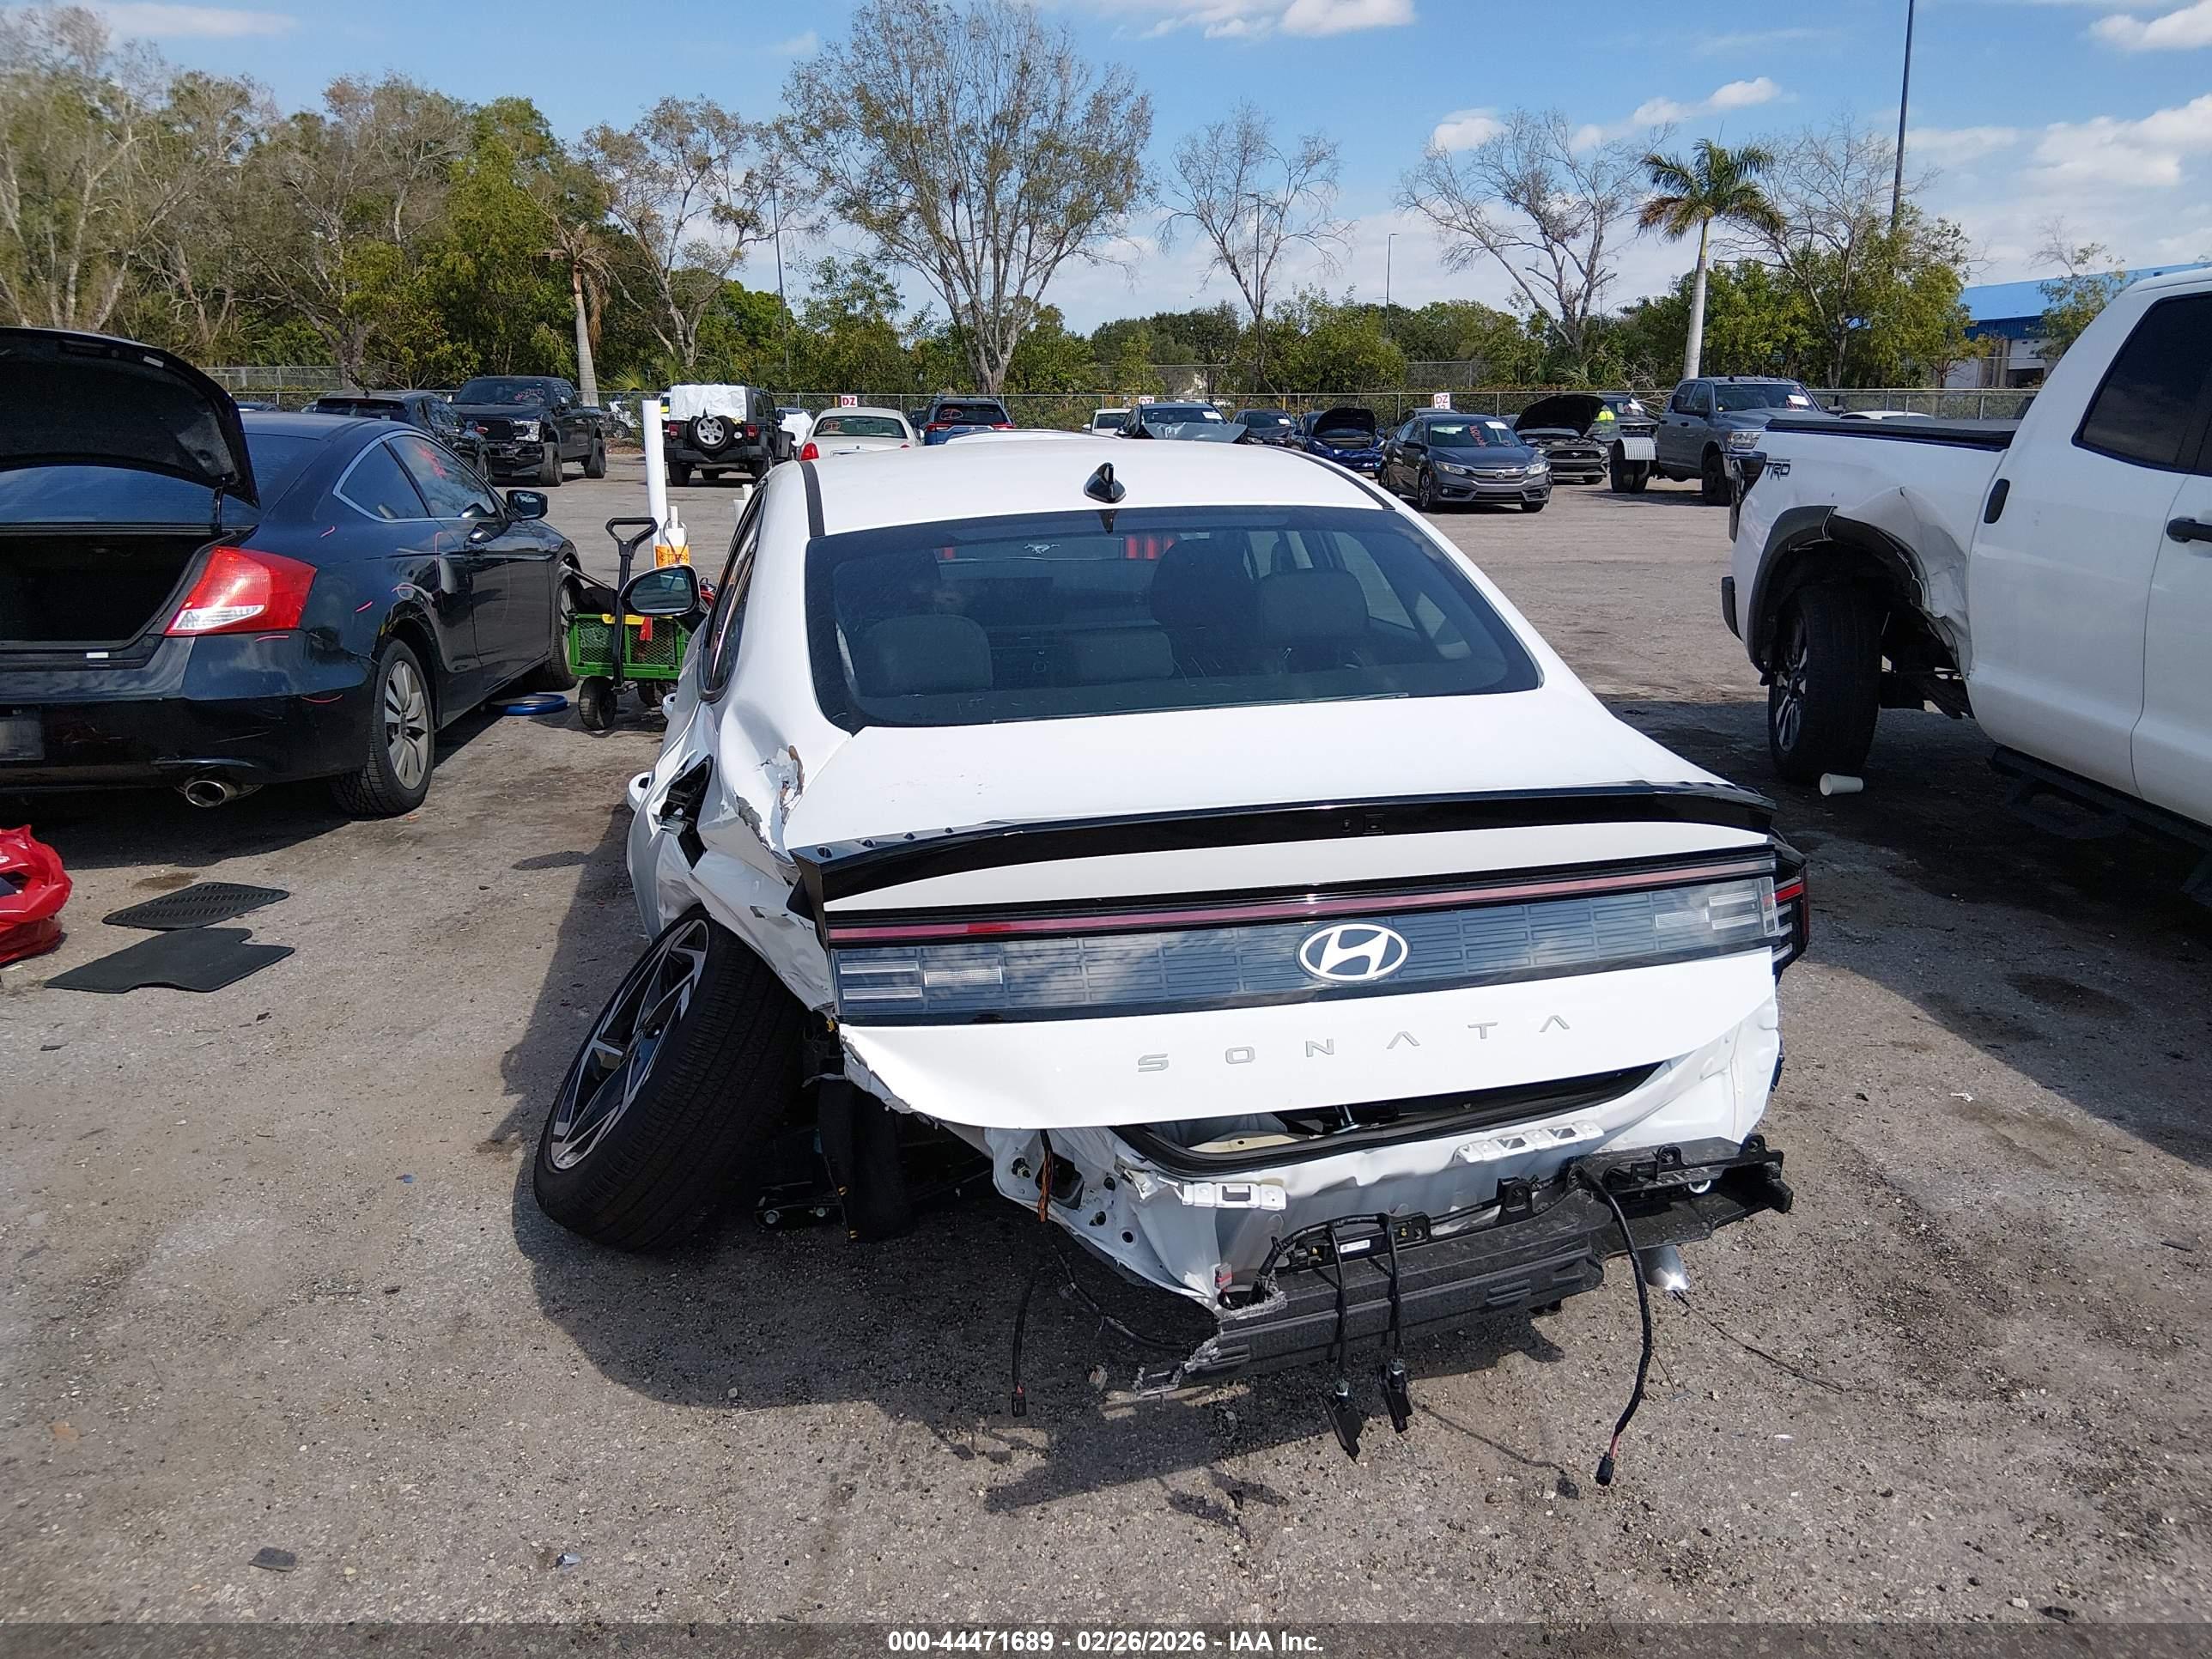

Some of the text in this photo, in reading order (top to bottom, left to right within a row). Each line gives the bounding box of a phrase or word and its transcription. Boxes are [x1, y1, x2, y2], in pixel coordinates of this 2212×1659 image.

[842, 397, 856, 406] DZ
[1435, 395, 1449, 404] DZ
[1765, 462, 1791, 481] TRD
[1138, 1014, 1571, 1073] SONATA
